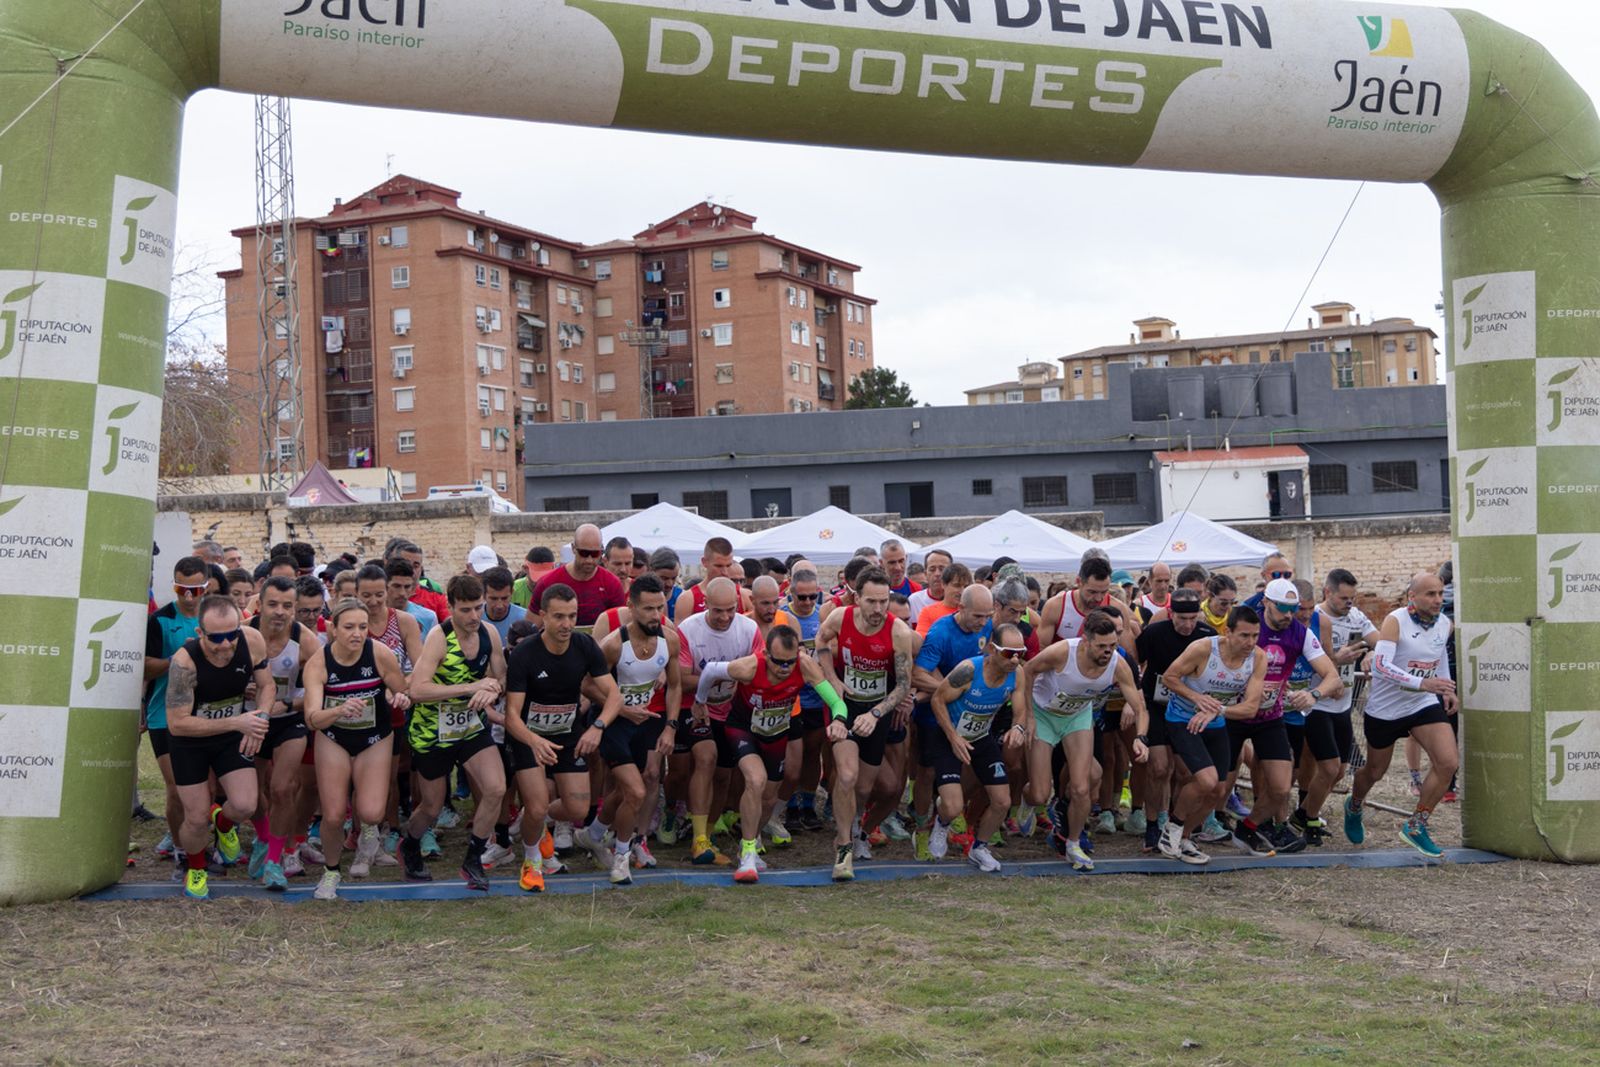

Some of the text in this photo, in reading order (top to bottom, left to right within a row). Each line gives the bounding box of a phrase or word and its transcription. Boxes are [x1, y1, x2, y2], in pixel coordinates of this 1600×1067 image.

[283, 20, 424, 49] Paraíso interior
[646, 17, 1147, 114] DEPORTES
[1330, 59, 1442, 117] Jaén
[1383, 119, 1436, 134] interior
[9, 212, 98, 228] DEPORTES
[138, 241, 150, 253] DE
[1473, 311, 1527, 323] DIPUTACIÓN
[19, 319, 92, 335] DIPUTACIÓN
[1473, 322, 1508, 334] DE JAÉN
[18, 332, 68, 345] DE JAÉN
[1564, 407, 1599, 417] DE JAÉN
[121, 450, 133, 461] DE
[1476, 486, 1529, 497] DIPUTACIÓN
[1476, 497, 1510, 508] DE JAÉN
[0, 534, 74, 548] DIPUTACIÓN
[0, 548, 48, 560] DE JAÉN
[1566, 585, 1579, 593] DE
[103, 662, 116, 673] DE
[1479, 662, 1530, 672] DIPUTACIÓN
[1479, 672, 1511, 682] DE JAÉN
[850, 677, 879, 690] 104
[623, 691, 651, 707] 233
[203, 705, 234, 719] 308
[530, 712, 572, 725] 4127
[1568, 762, 1580, 771] DE
